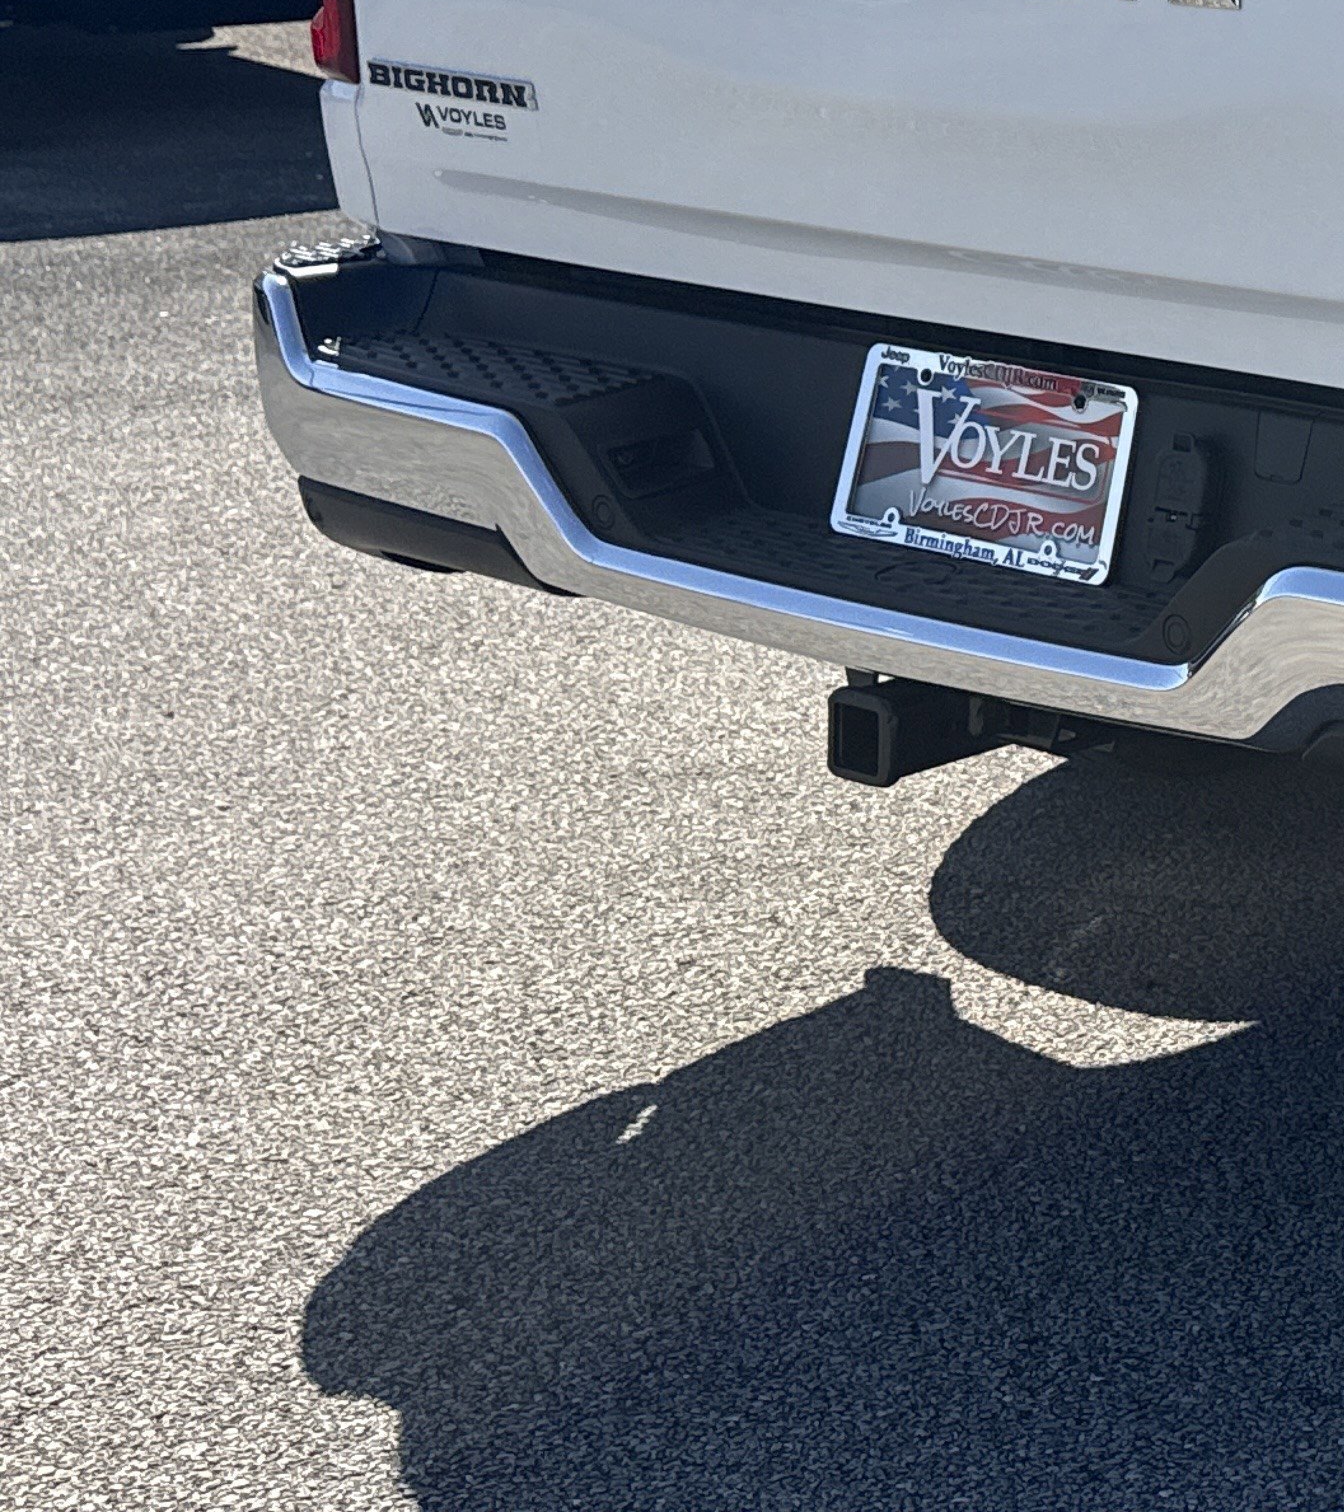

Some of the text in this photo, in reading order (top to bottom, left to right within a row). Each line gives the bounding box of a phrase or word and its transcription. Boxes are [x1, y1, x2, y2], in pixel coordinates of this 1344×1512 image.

[367, 61, 528, 108] BIGHORN
[436, 105, 507, 130] VOYLES
[881, 346, 910, 364] Jeep
[917, 388, 1100, 491] VOYLES
[904, 528, 1026, 568] Birmingham, AL
